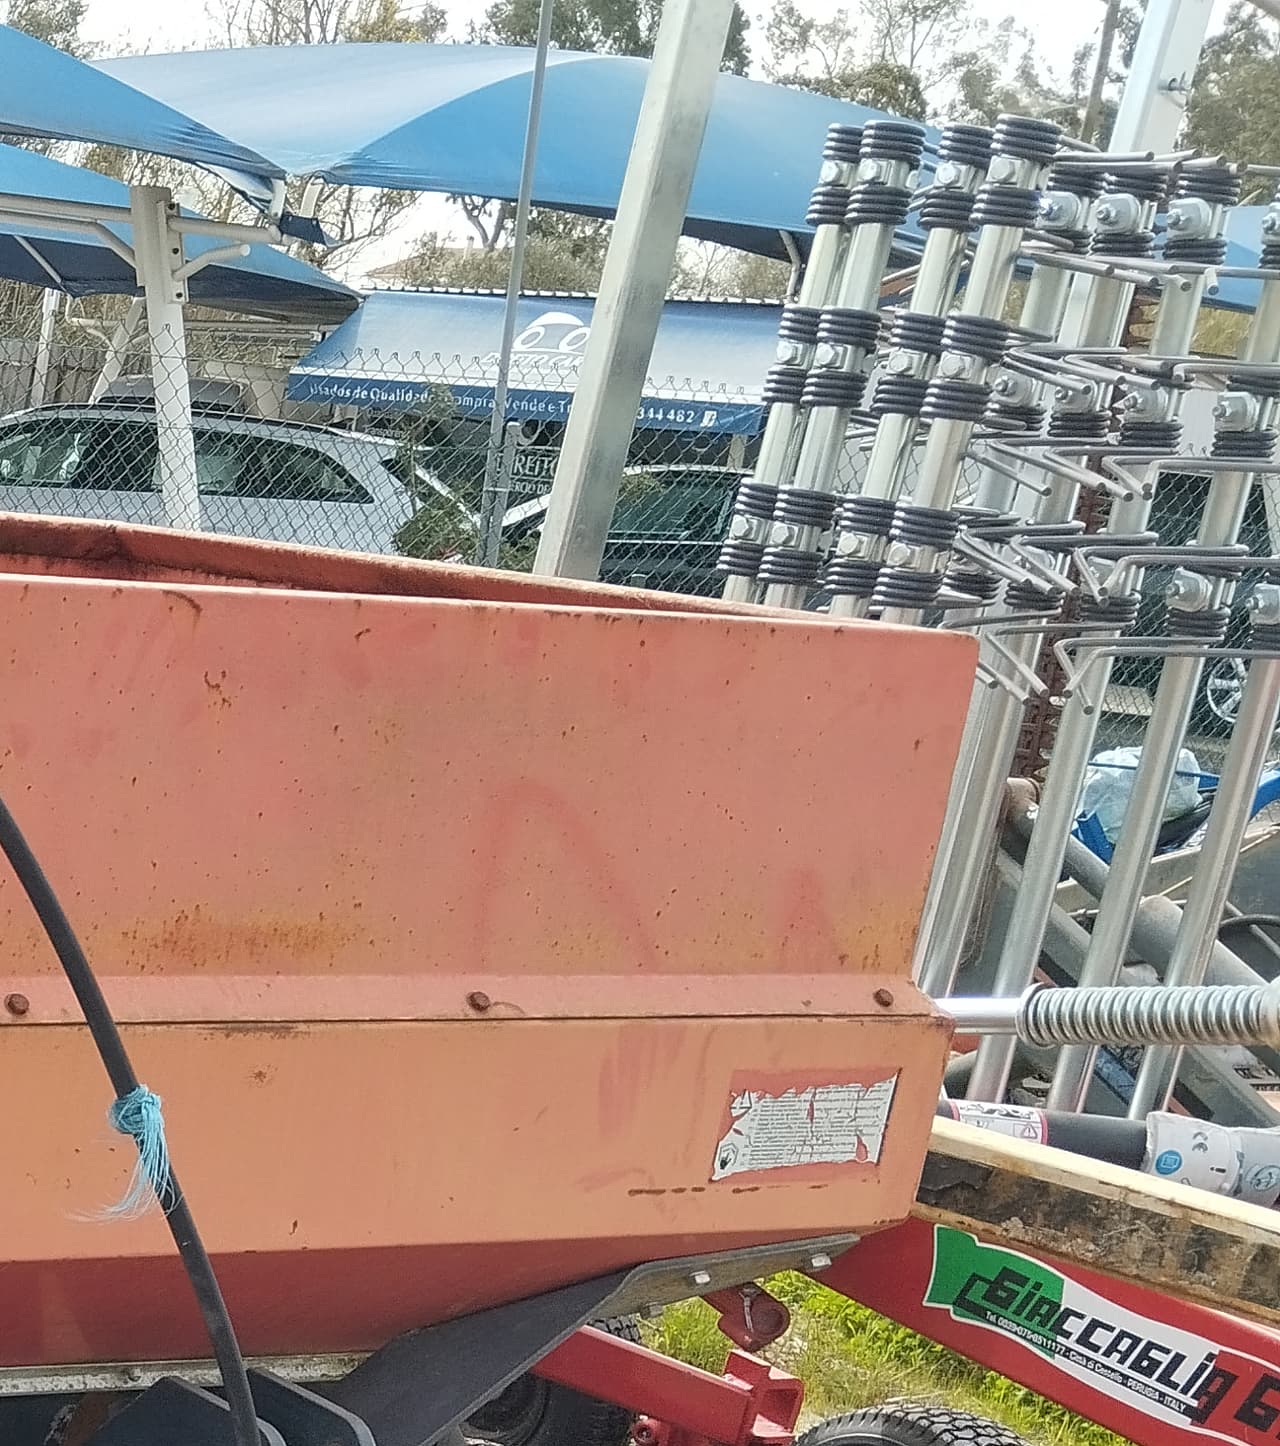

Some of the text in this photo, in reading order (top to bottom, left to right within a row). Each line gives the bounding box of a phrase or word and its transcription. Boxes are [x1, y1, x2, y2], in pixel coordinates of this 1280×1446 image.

[310, 383, 351, 397] Usados
[352, 386, 368, 398] de
[453, 395, 496, 410] ompra
[1127, 1378, 1159, 1400] PERUGIA
[1163, 1396, 1187, 1413] ITALY
